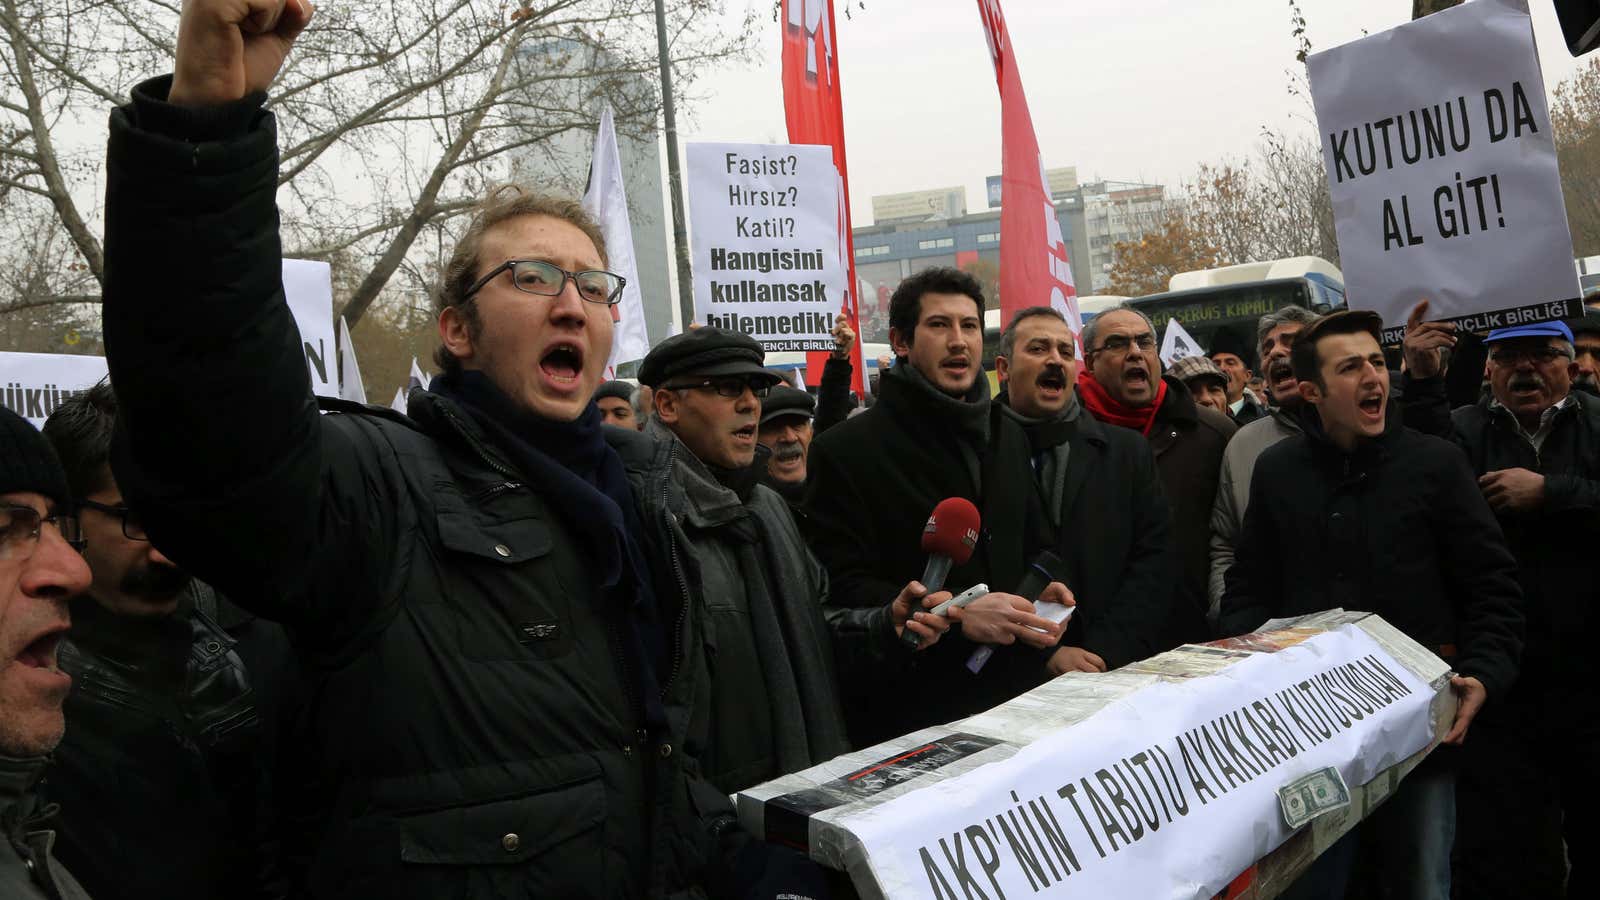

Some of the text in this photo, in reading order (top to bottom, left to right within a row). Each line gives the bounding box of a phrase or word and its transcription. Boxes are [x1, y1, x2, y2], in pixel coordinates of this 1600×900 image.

[1330, 81, 1538, 183] KUTUNU DA
[726, 152, 798, 178] Faşist?
[729, 184, 798, 207] Hırsız?
[1382, 172, 1506, 251] AL GİT!
[736, 215, 795, 238] Katil?
[710, 247, 824, 273] Hangisini
[711, 280, 827, 303] kullansak
[1454, 312, 1502, 333] NÇLİK
[1506, 301, 1568, 325] BİRLİĞİ
[760, 340, 801, 351] ENÇLİK
[918, 790, 1082, 900] AKP'NİN
[1056, 745, 1189, 858] TABUTU
[1175, 697, 1307, 805] AYAKKABI
[1275, 654, 1412, 747] KUTUSUNDAN
